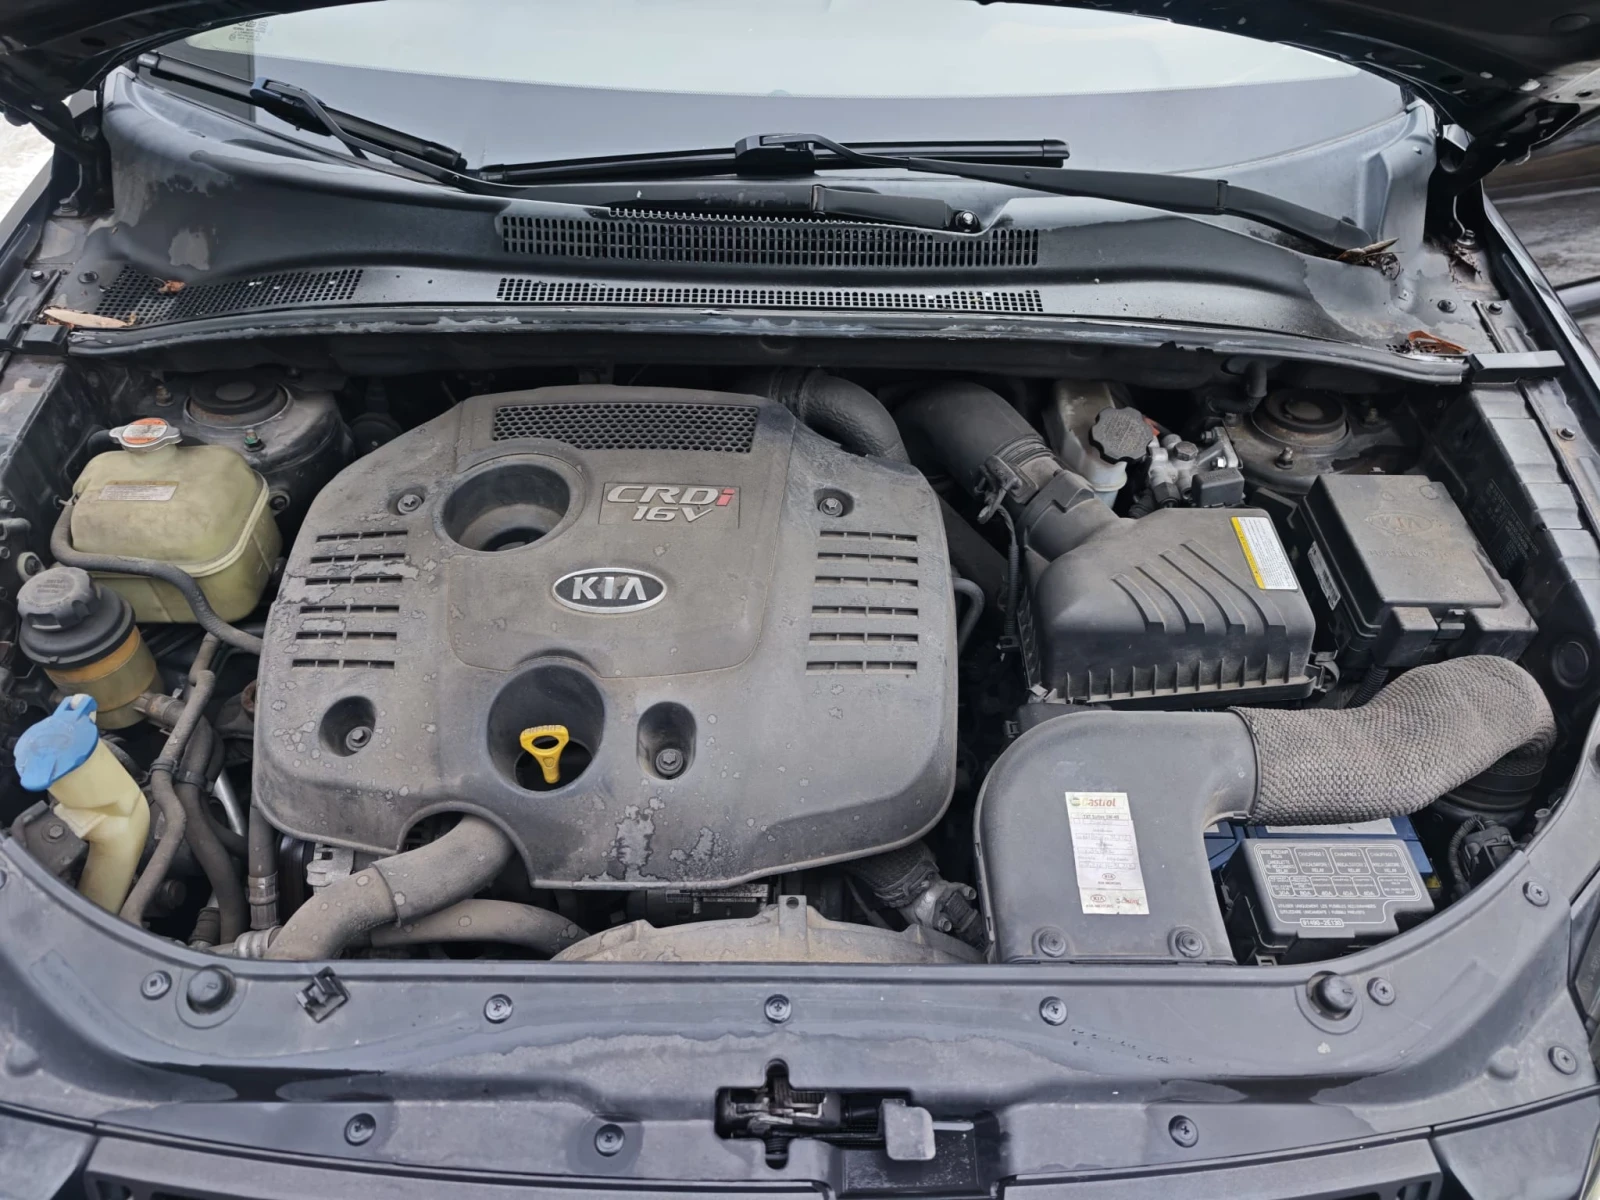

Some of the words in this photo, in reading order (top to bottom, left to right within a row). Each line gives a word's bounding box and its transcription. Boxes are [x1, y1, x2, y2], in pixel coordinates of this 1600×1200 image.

[607, 485, 735, 506] CRDi
[632, 505, 713, 523] 16V
[572, 576, 647, 601] KIA
